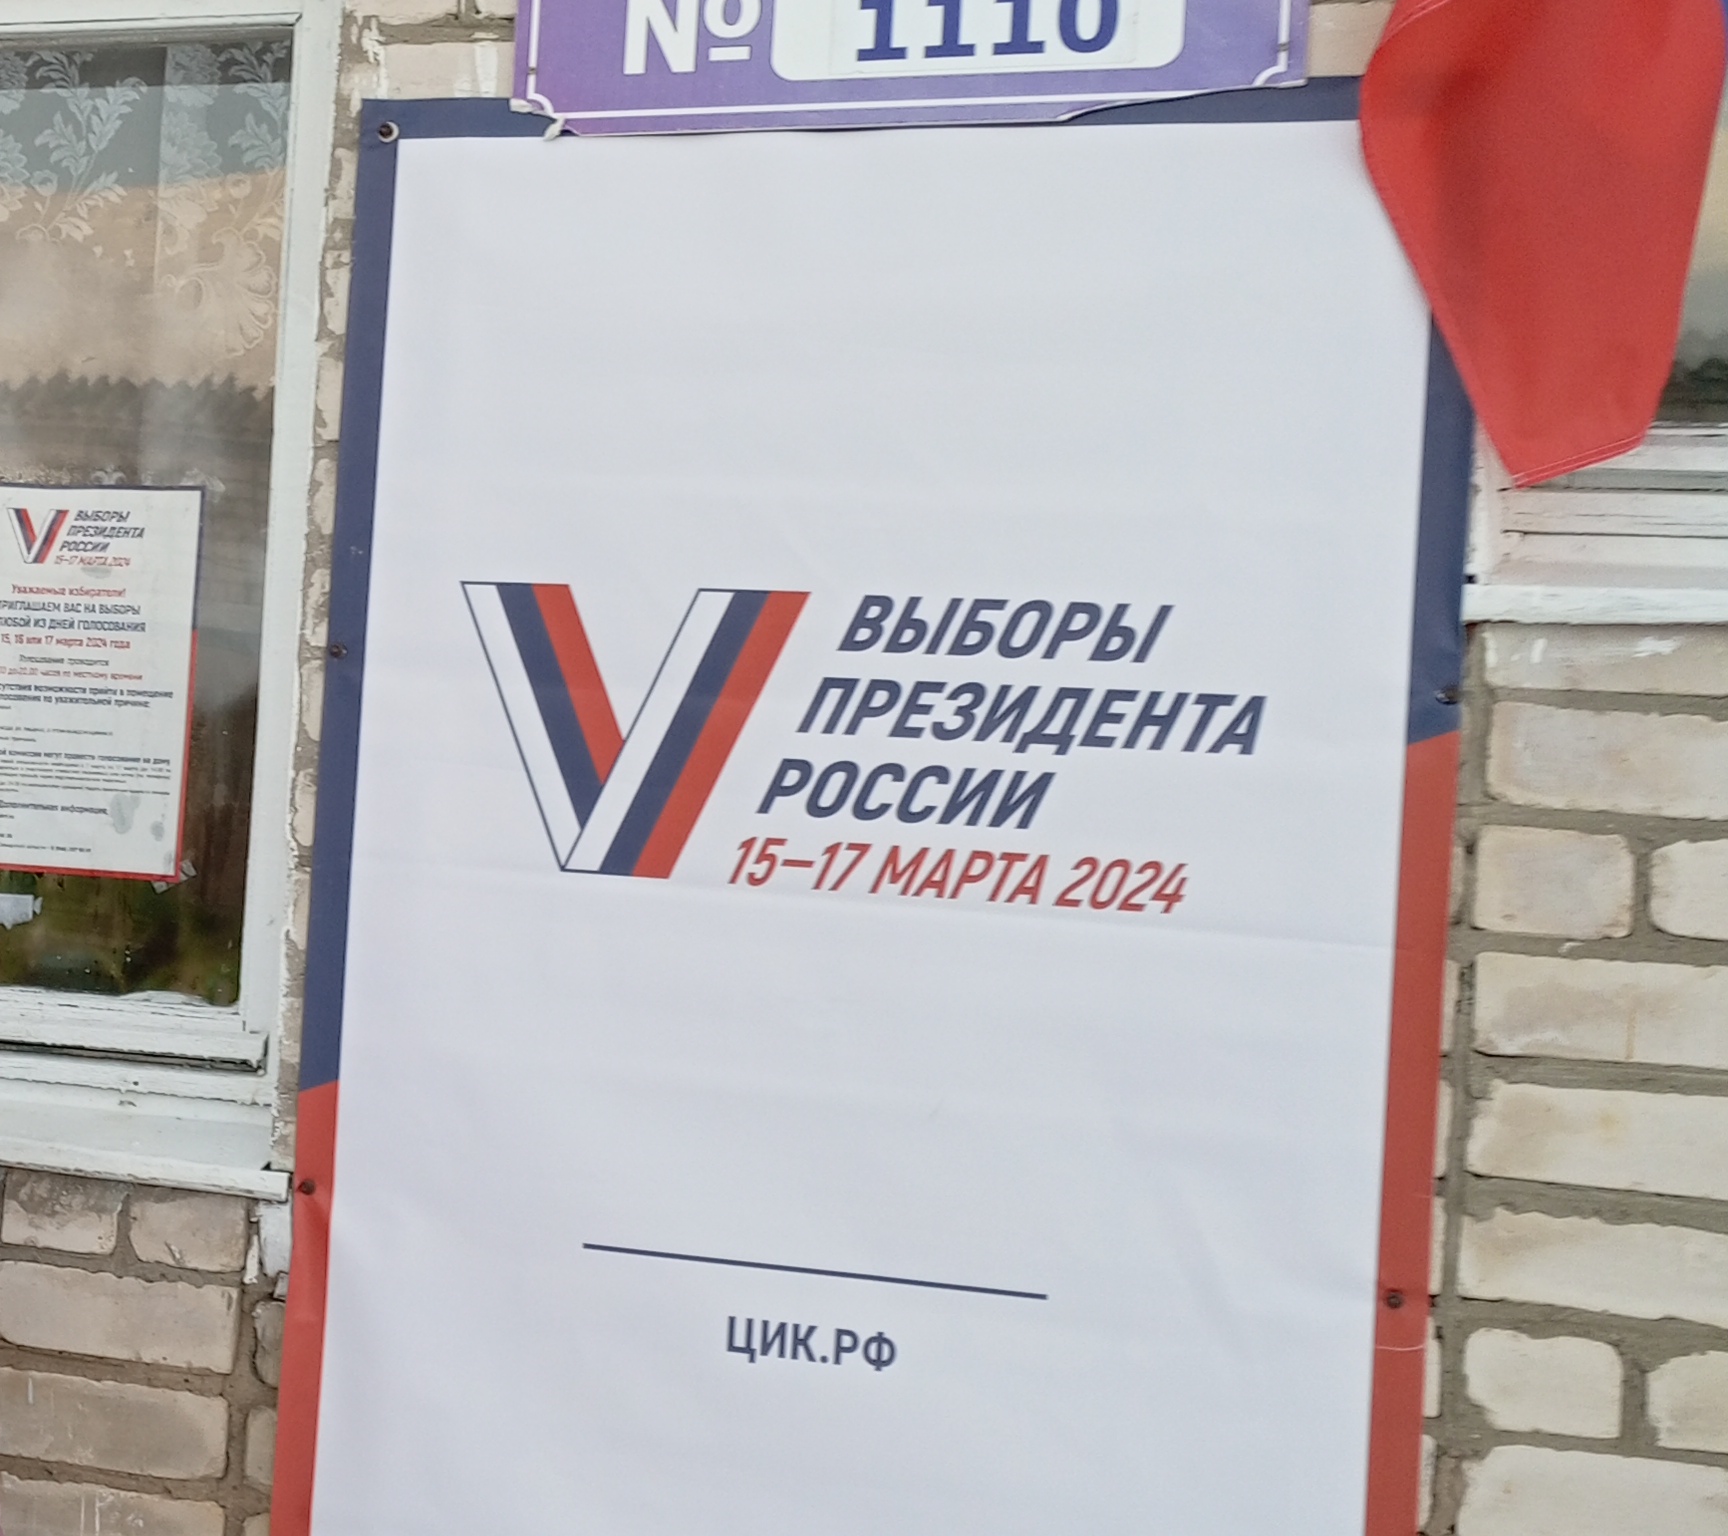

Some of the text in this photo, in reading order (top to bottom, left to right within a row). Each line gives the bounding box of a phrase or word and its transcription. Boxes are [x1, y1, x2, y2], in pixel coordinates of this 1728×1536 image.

[837, 594, 1175, 665] ВЫБОРЫ
[795, 676, 1269, 757] ПРЕЗИДЕНТА
[755, 758, 1056, 831] РОССИИ
[866, 844, 1054, 907] МАРТА
[1055, 855, 1189, 915] 2024
[726, 1315, 897, 1372] ЦИК.РФ
